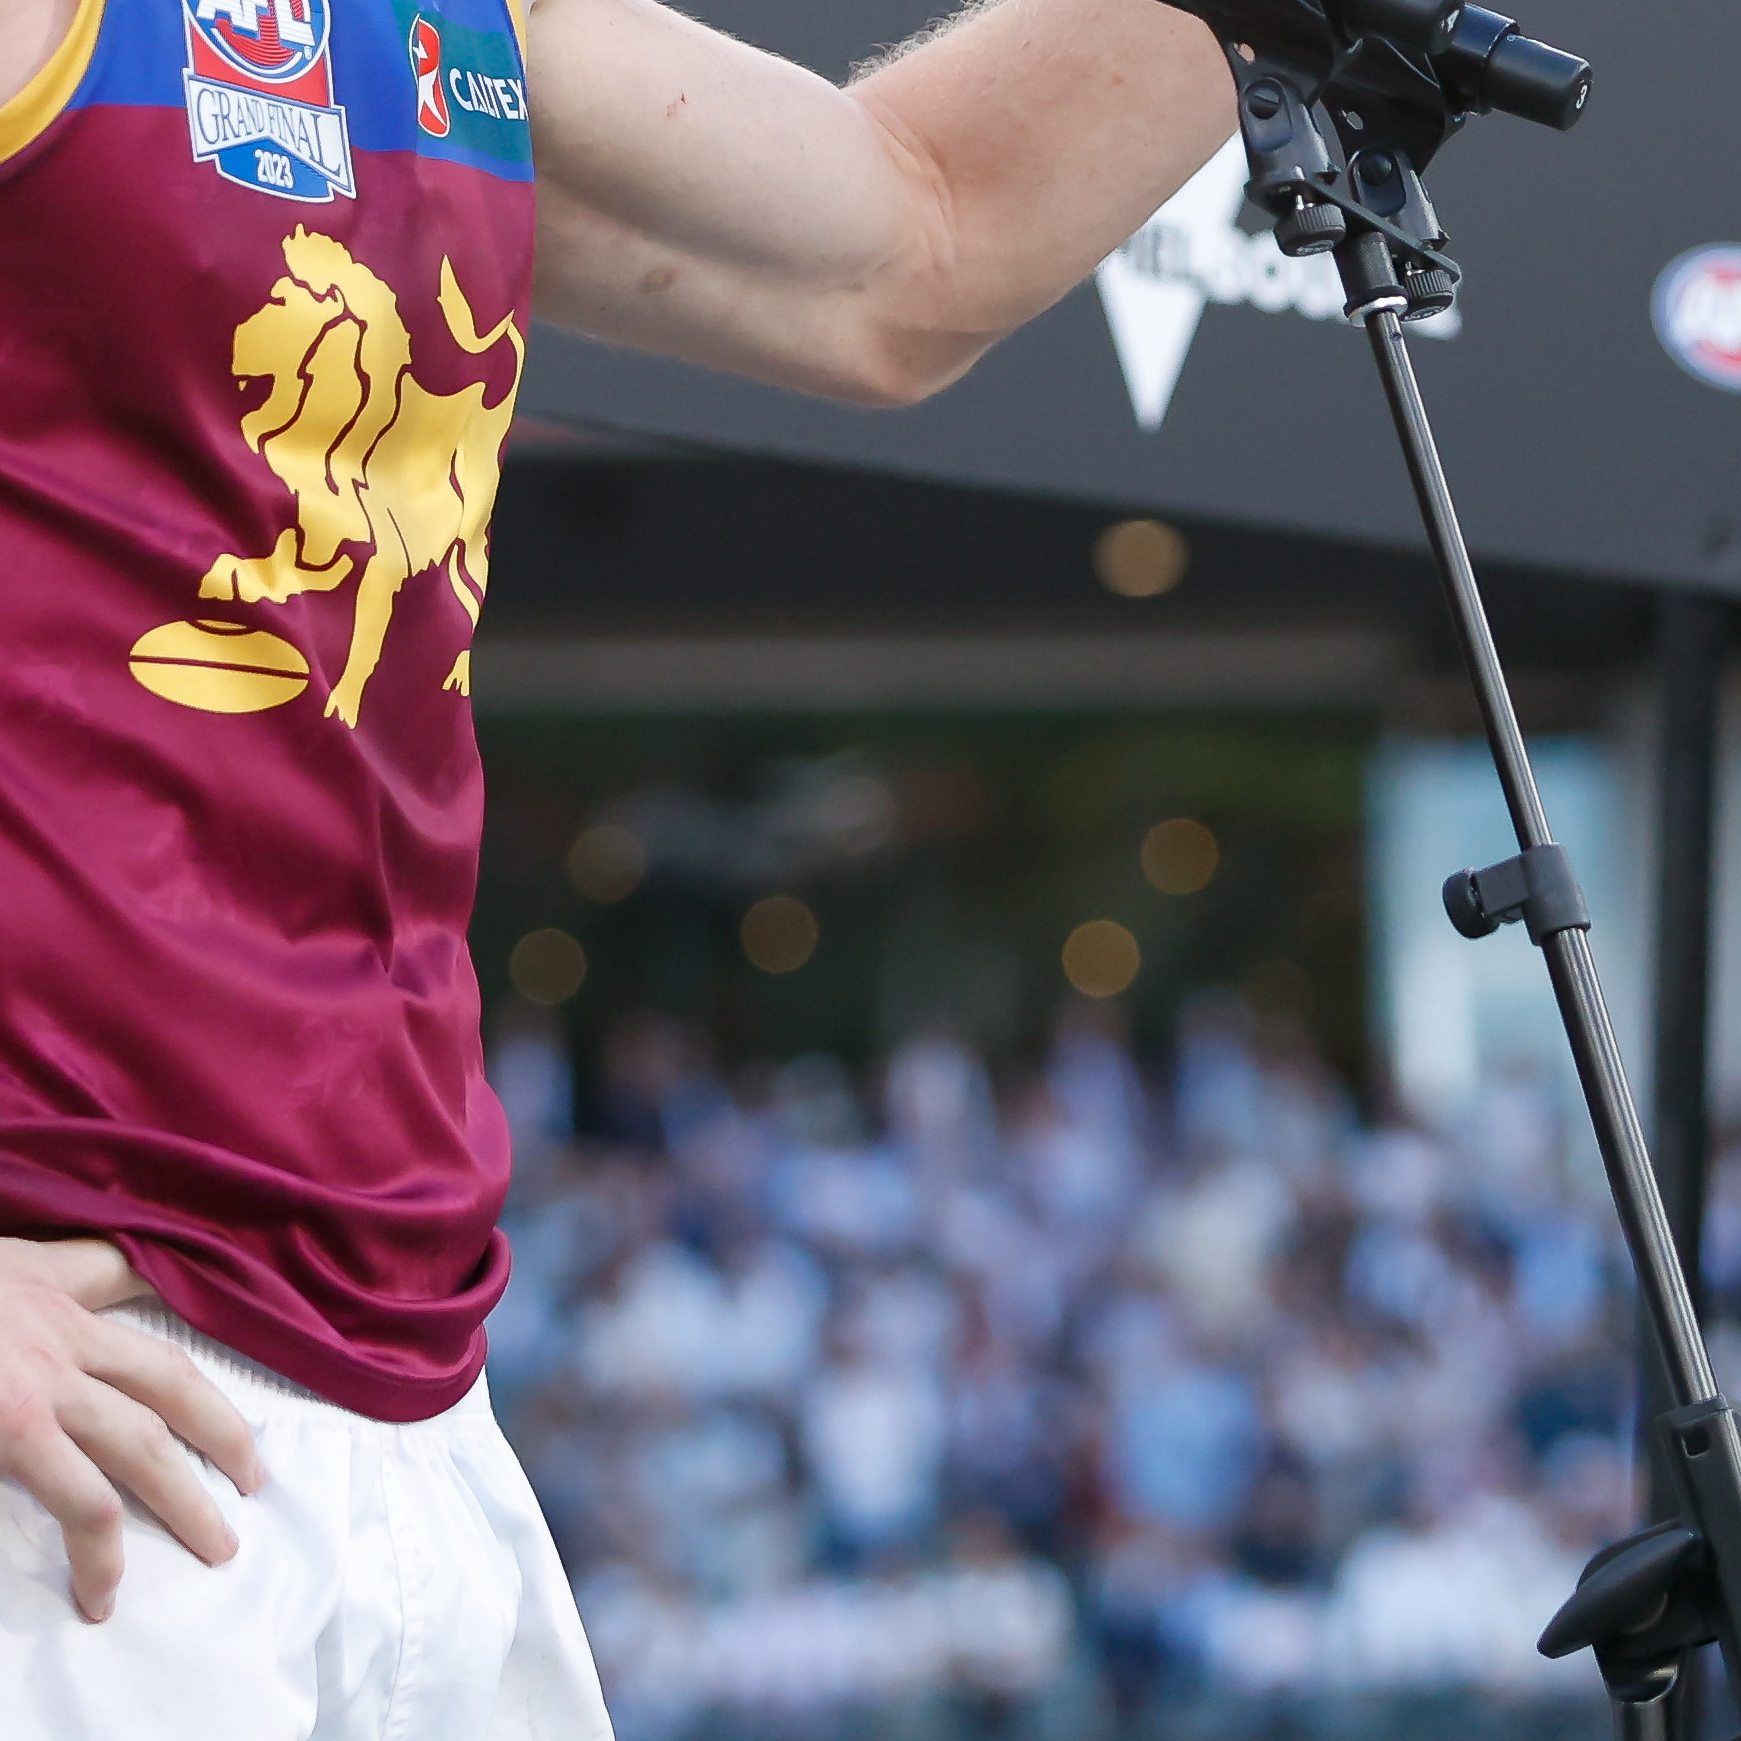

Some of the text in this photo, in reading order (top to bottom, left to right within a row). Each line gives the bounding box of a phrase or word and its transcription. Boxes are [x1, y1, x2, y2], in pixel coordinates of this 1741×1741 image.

[449, 67, 529, 121] CALTEX
[196, 86, 342, 178] GRAND FINAL
[253, 148, 295, 190] 2023
